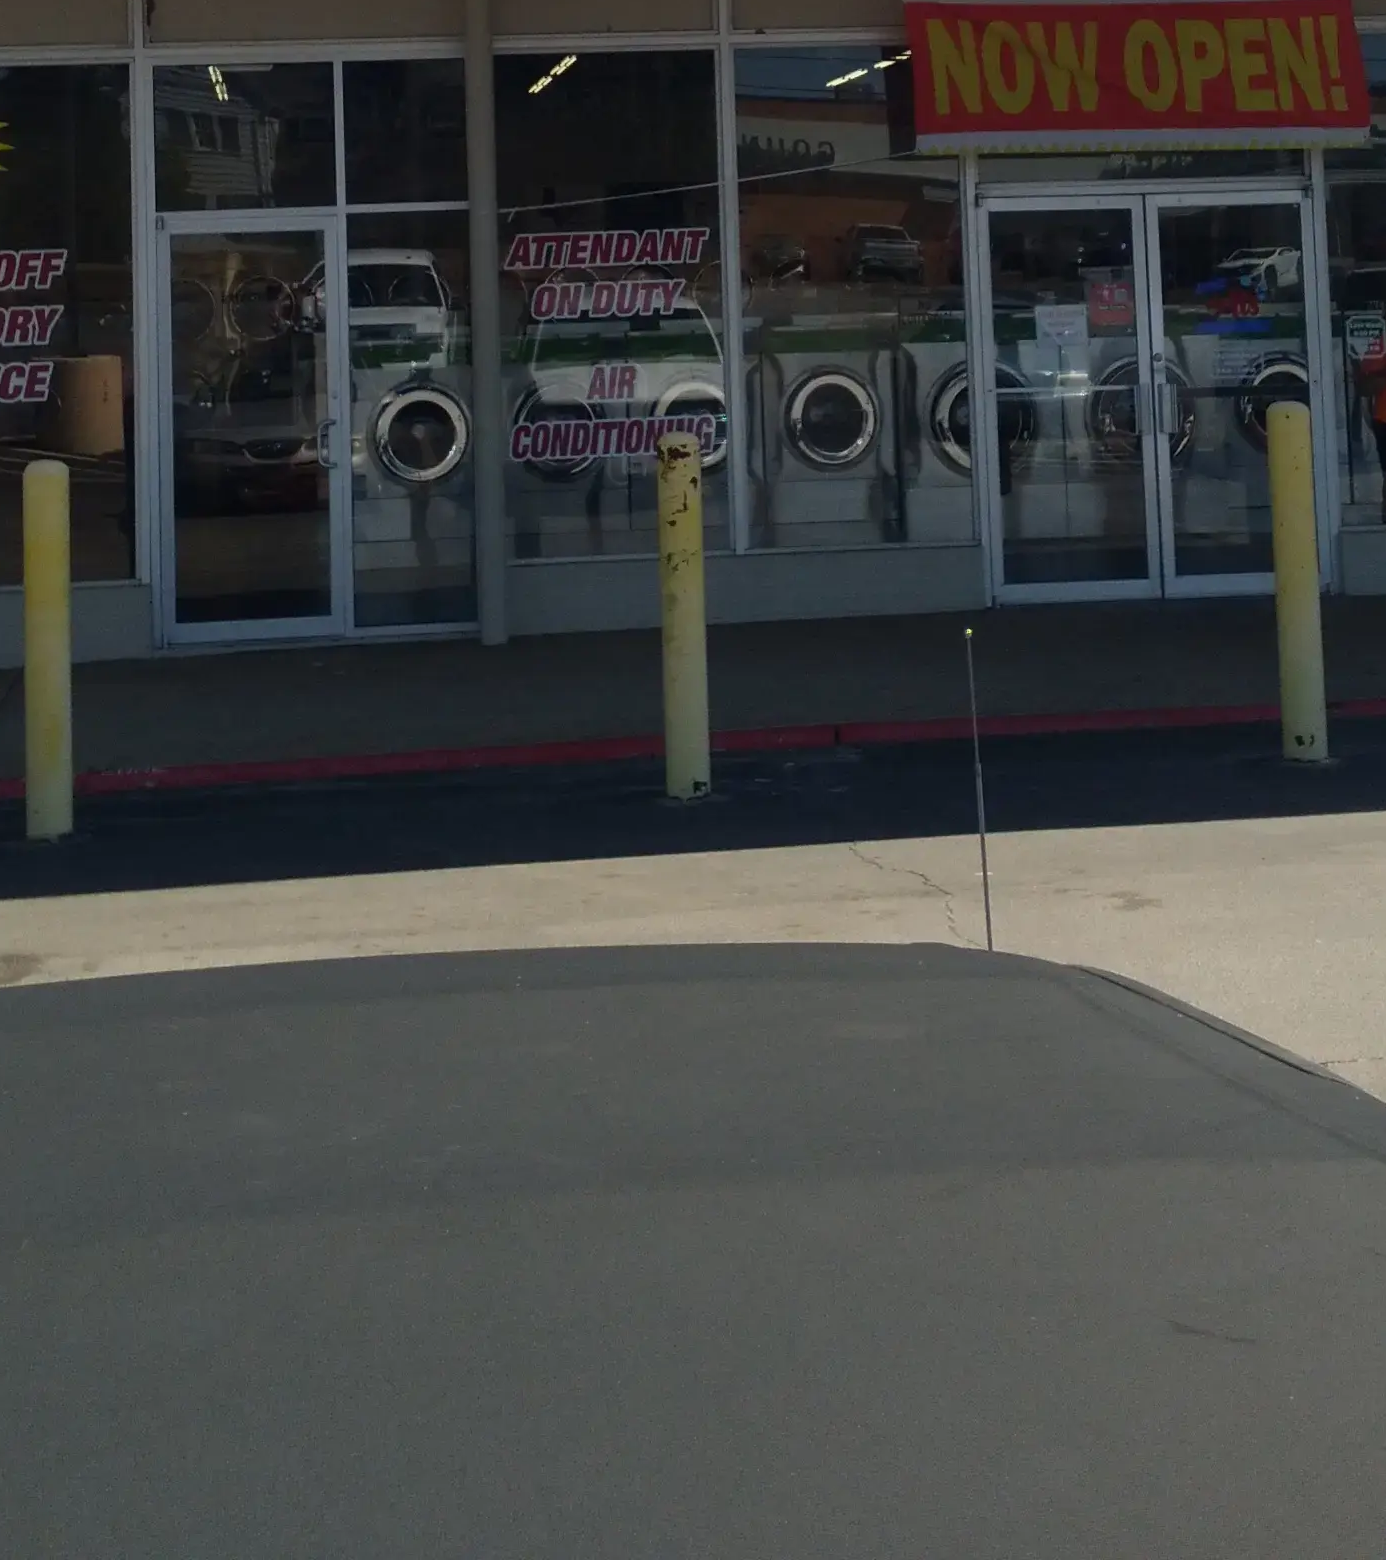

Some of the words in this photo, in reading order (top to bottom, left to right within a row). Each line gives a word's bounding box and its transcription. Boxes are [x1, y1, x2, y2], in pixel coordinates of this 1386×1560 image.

[925, 18, 1100, 115] NOW
[1123, 14, 1350, 113] OPEN!
[504, 228, 710, 270] ATTENDANT
[531, 283, 584, 320] ON
[589, 280, 686, 317] DUTY
[586, 364, 638, 400] AIR
